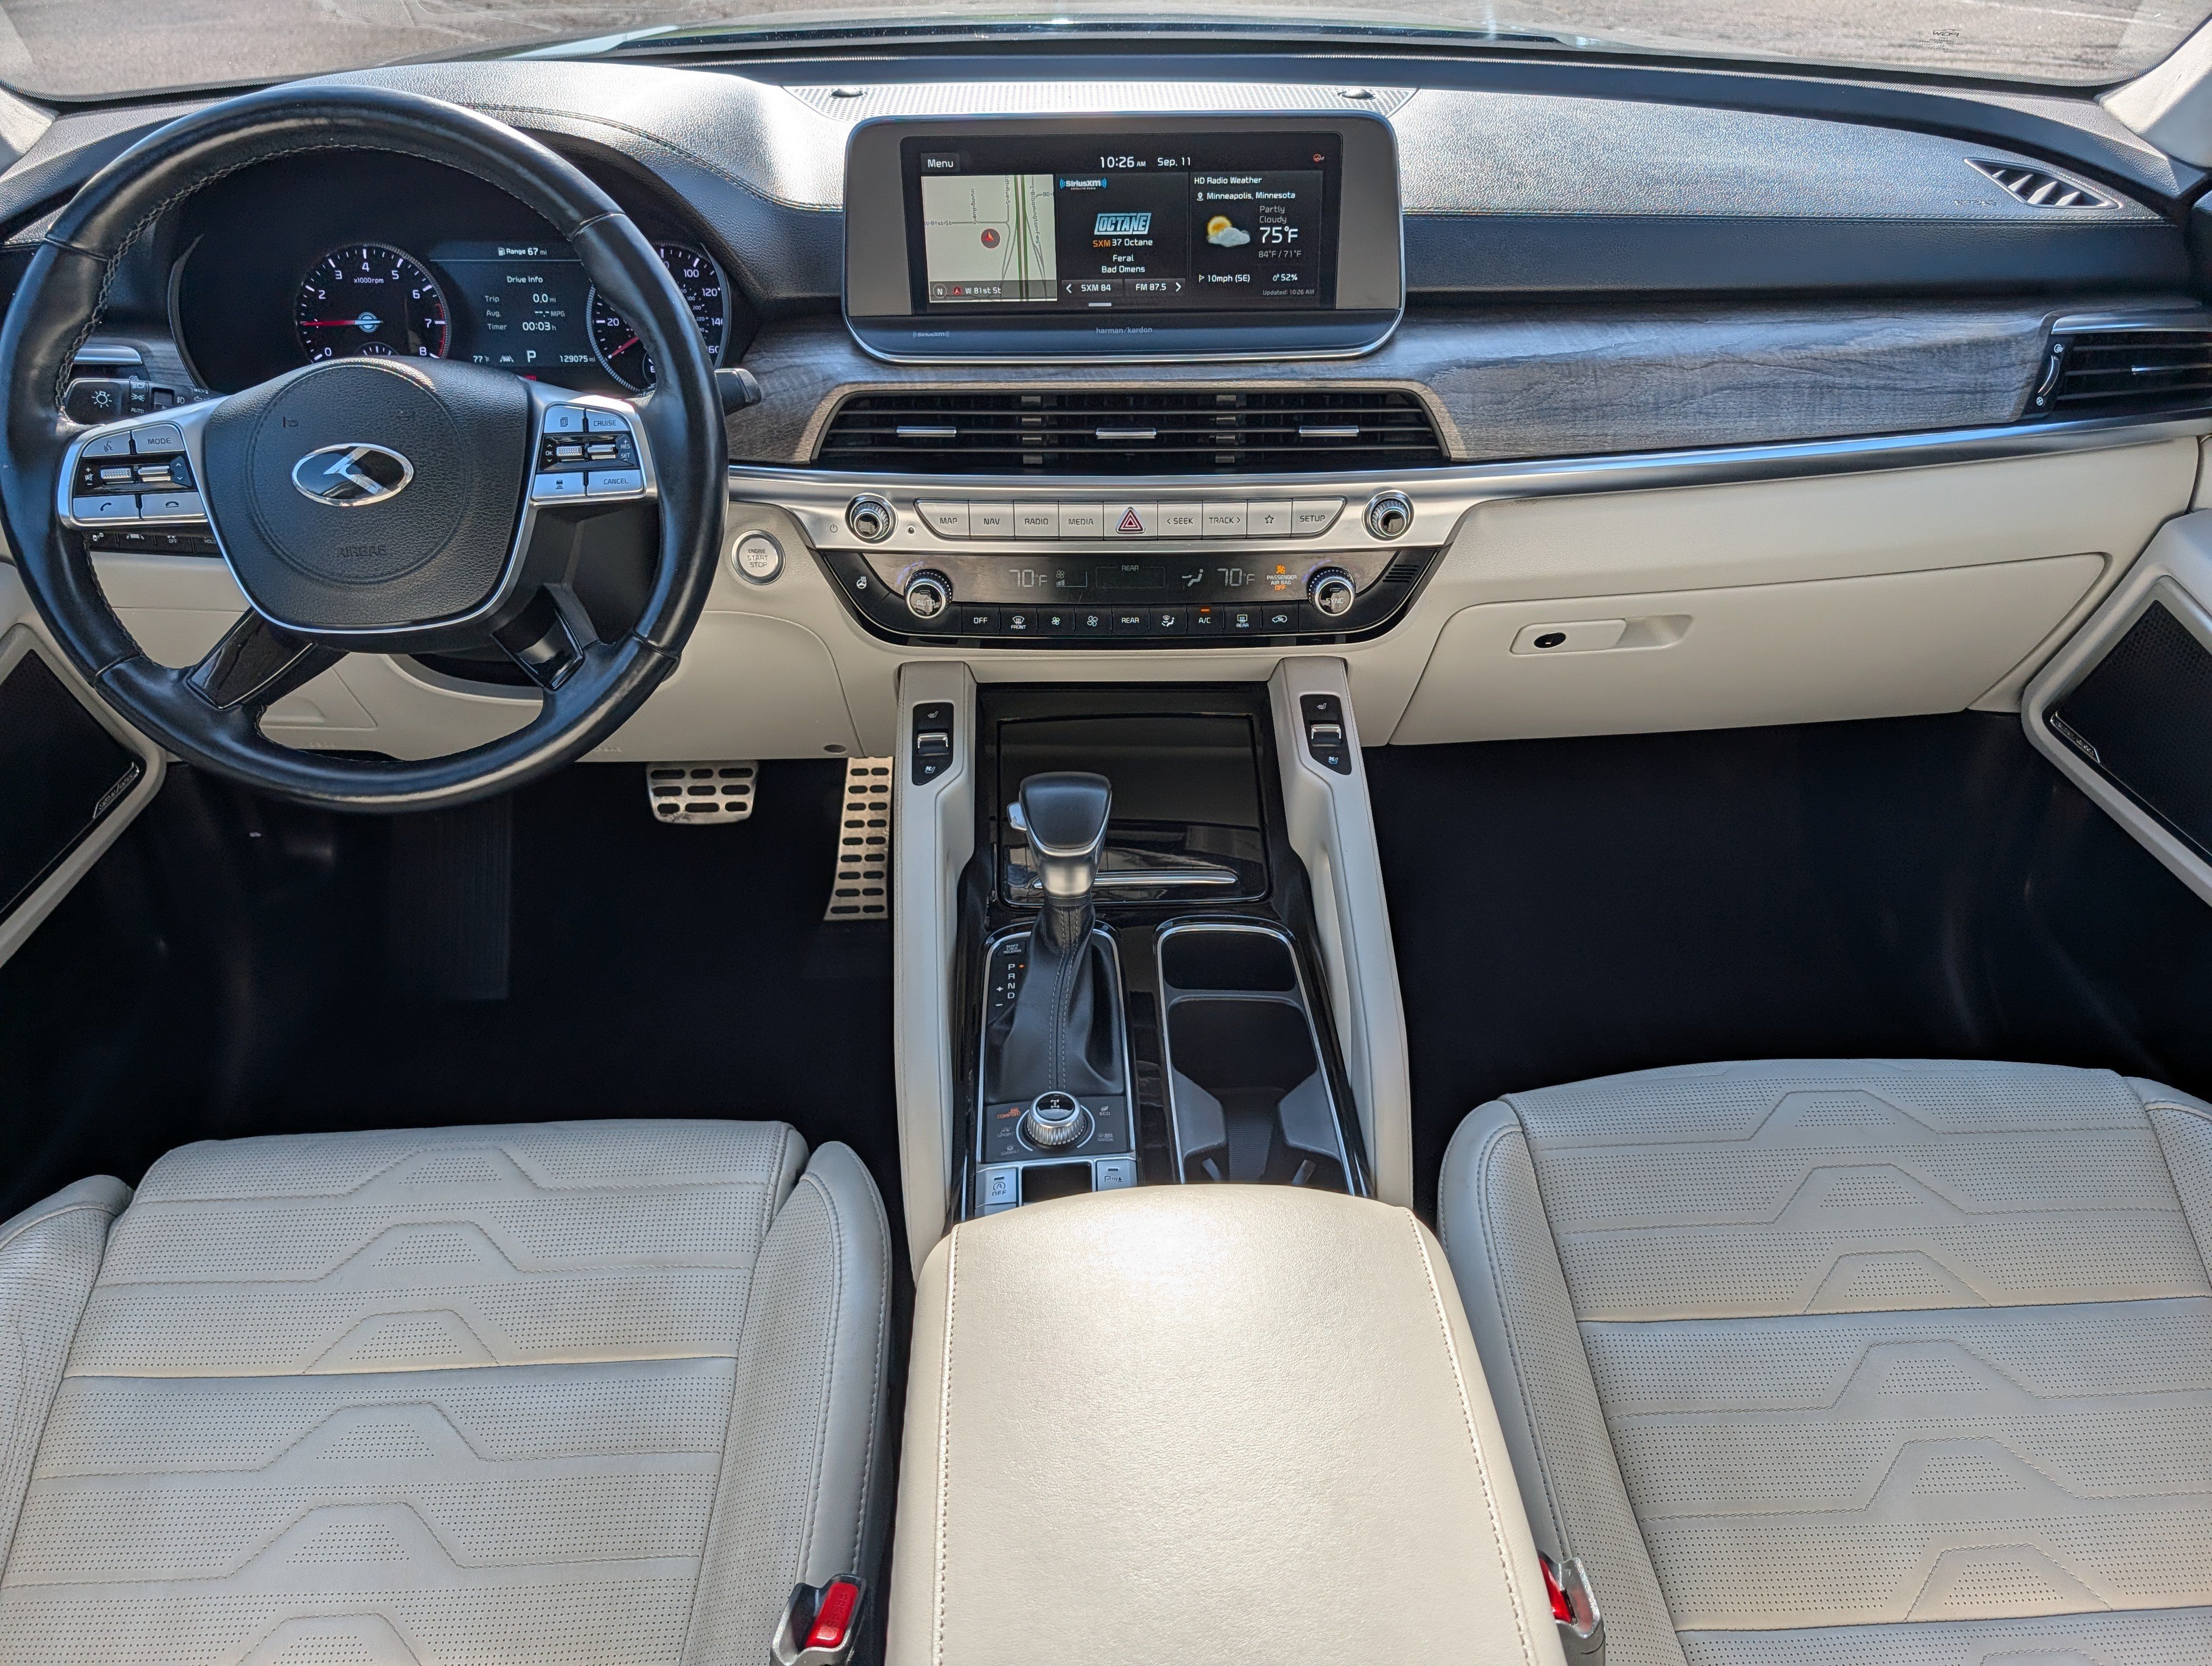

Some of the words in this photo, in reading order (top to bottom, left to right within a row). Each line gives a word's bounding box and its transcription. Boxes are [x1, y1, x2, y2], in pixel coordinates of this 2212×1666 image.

[928, 159, 954, 168] Menu
[1100, 156, 1134, 168] 10:26
[1158, 157, 1178, 167] Sep.
[1181, 157, 1191, 166] 11
[1207, 193, 1253, 201] Minneapolis,
[1030, 191, 1039, 230] Bloomington
[1259, 206, 1285, 214] Partly
[1098, 216, 1148, 232] OCTANE
[1259, 216, 1287, 224] Cloudy
[1259, 226, 1298, 244] 75°F
[528, 247, 538, 256] 67
[362, 262, 370, 272] 4
[335, 270, 343, 280] 3
[391, 270, 399, 280] 5
[684, 269, 699, 278] 100
[1235, 274, 1250, 283] (SE)
[318, 290, 326, 299] 2
[413, 290, 420, 299] 6
[702, 288, 718, 297] 120
[532, 293, 548, 304] 0.0
[486, 310, 501, 318] Avg.
[424, 318, 432, 328] 7
[522, 322, 551, 331] 00:03
[325, 347, 332, 356] 0
[419, 347, 427, 356] 8
[526, 350, 537, 363] P
[147, 437, 172, 445] MODE
